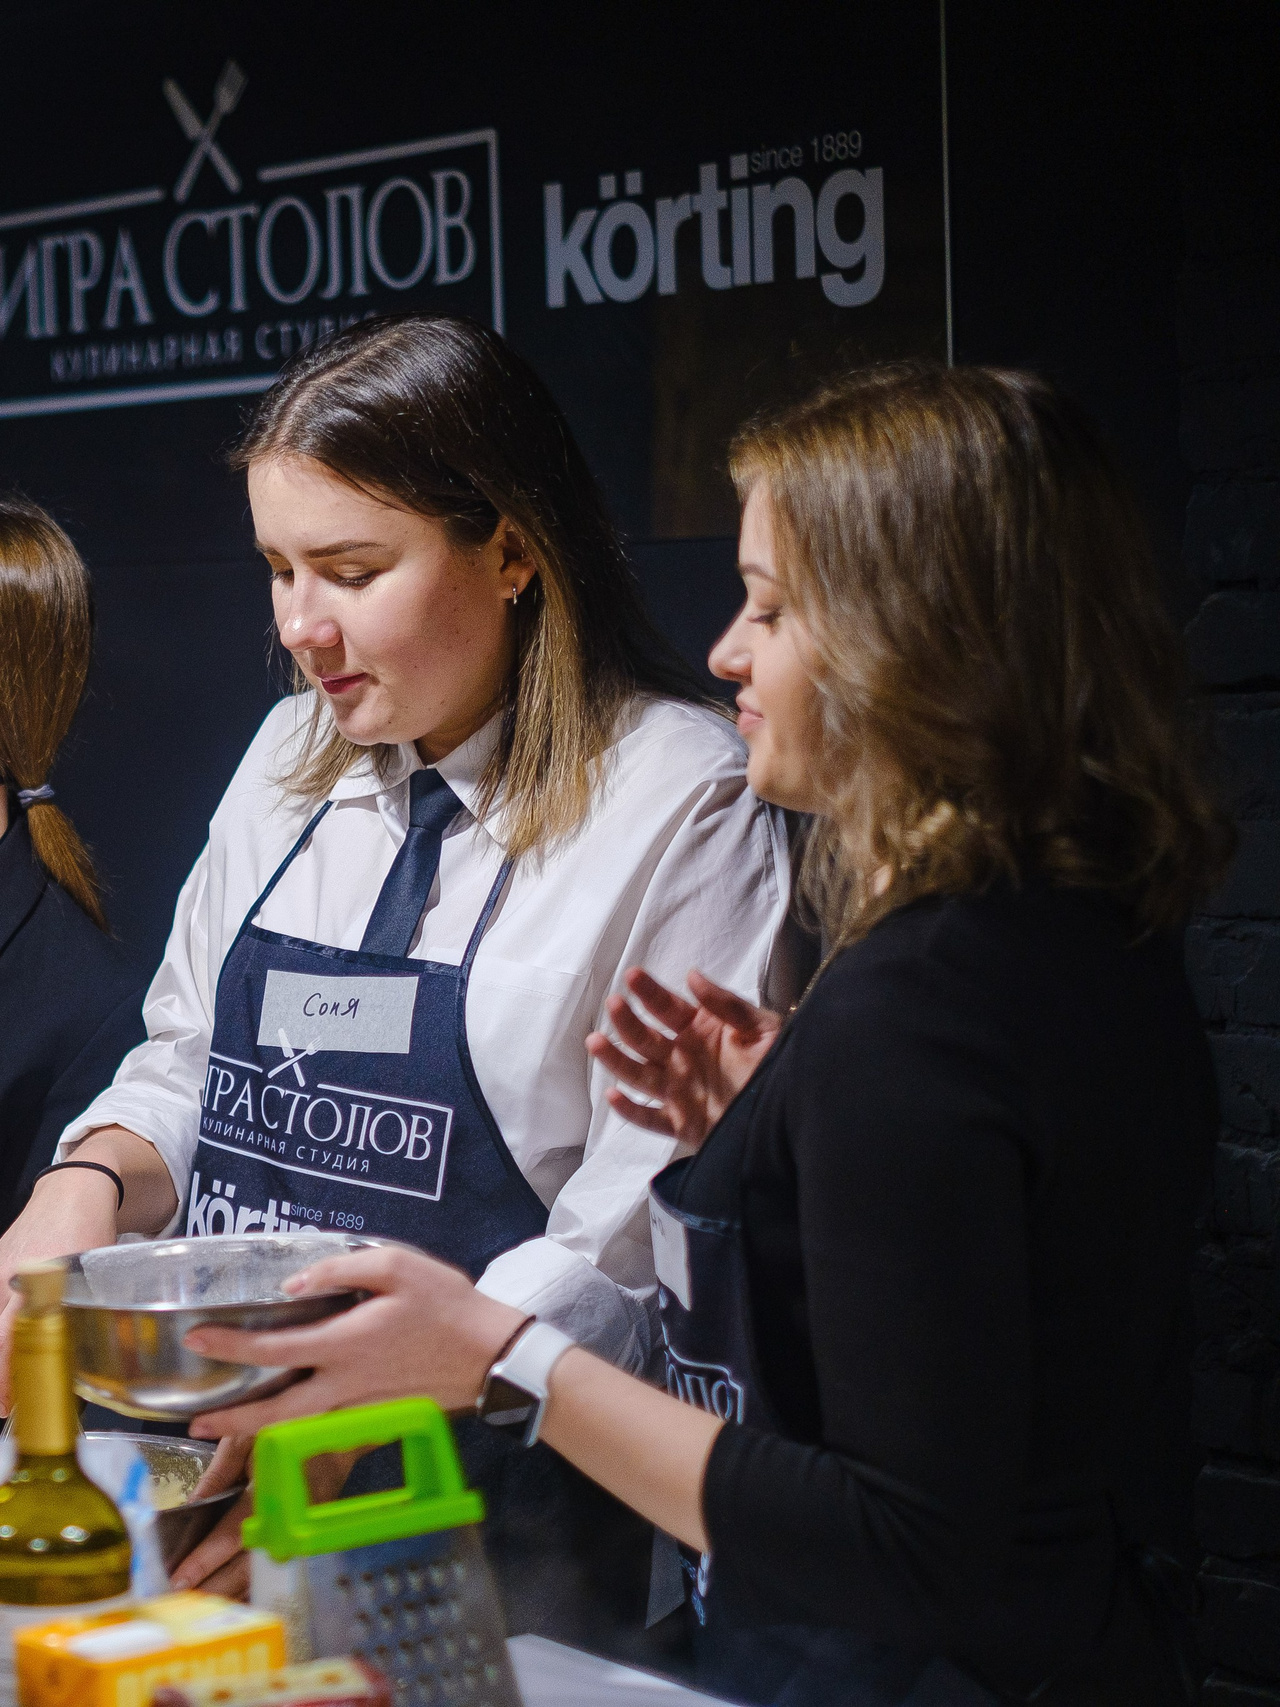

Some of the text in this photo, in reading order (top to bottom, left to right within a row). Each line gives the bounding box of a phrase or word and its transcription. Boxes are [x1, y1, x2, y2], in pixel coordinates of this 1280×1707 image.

[750, 129, 863, 174] since 1889
[161, 167, 477, 318] СТОЛОВ
[542, 153, 886, 309] körting
[201, 1064, 435, 1162] ГРА СТОЛОВ
[202, 1115, 371, 1174] КУЛИНАРНАЯ СТУДИЯ
[290, 1202, 365, 1231] since 1889
